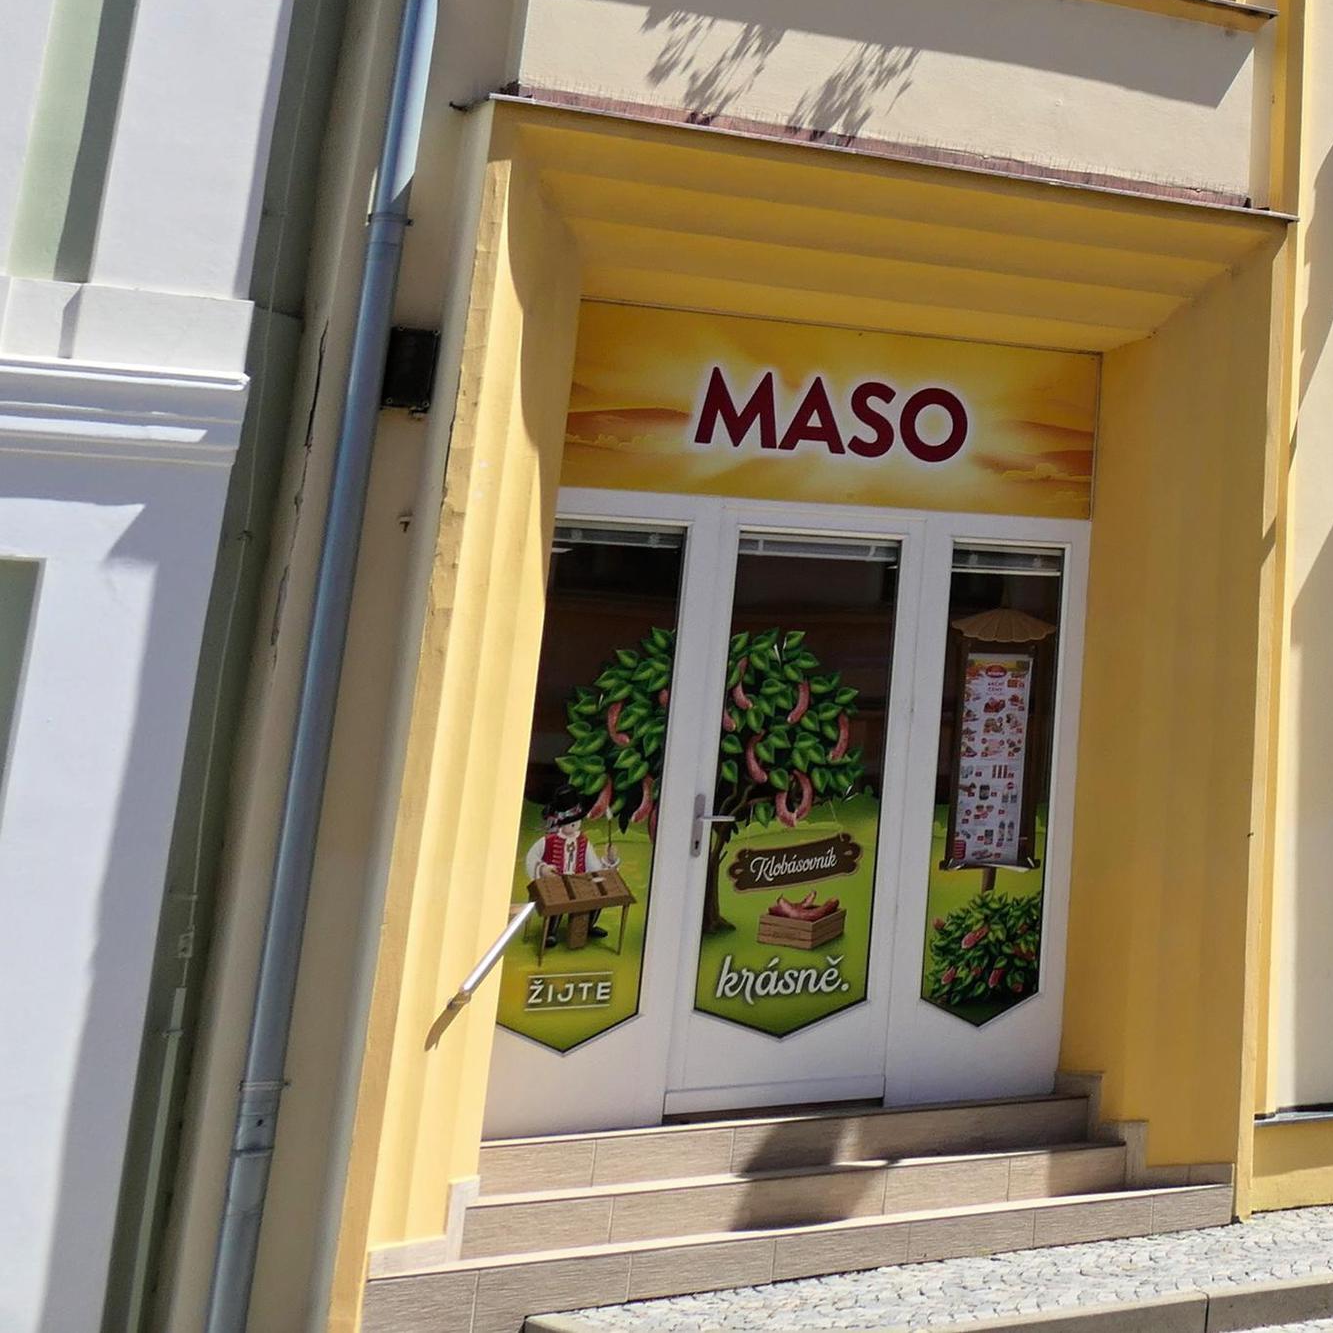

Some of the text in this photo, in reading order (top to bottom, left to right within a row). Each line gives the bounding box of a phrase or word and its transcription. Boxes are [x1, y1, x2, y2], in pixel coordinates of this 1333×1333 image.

[694, 366, 968, 463] MASO
[750, 846, 838, 882] Klobásovník
[527, 979, 612, 1004] ŽIJTE
[715, 955, 849, 1005] krásně.
